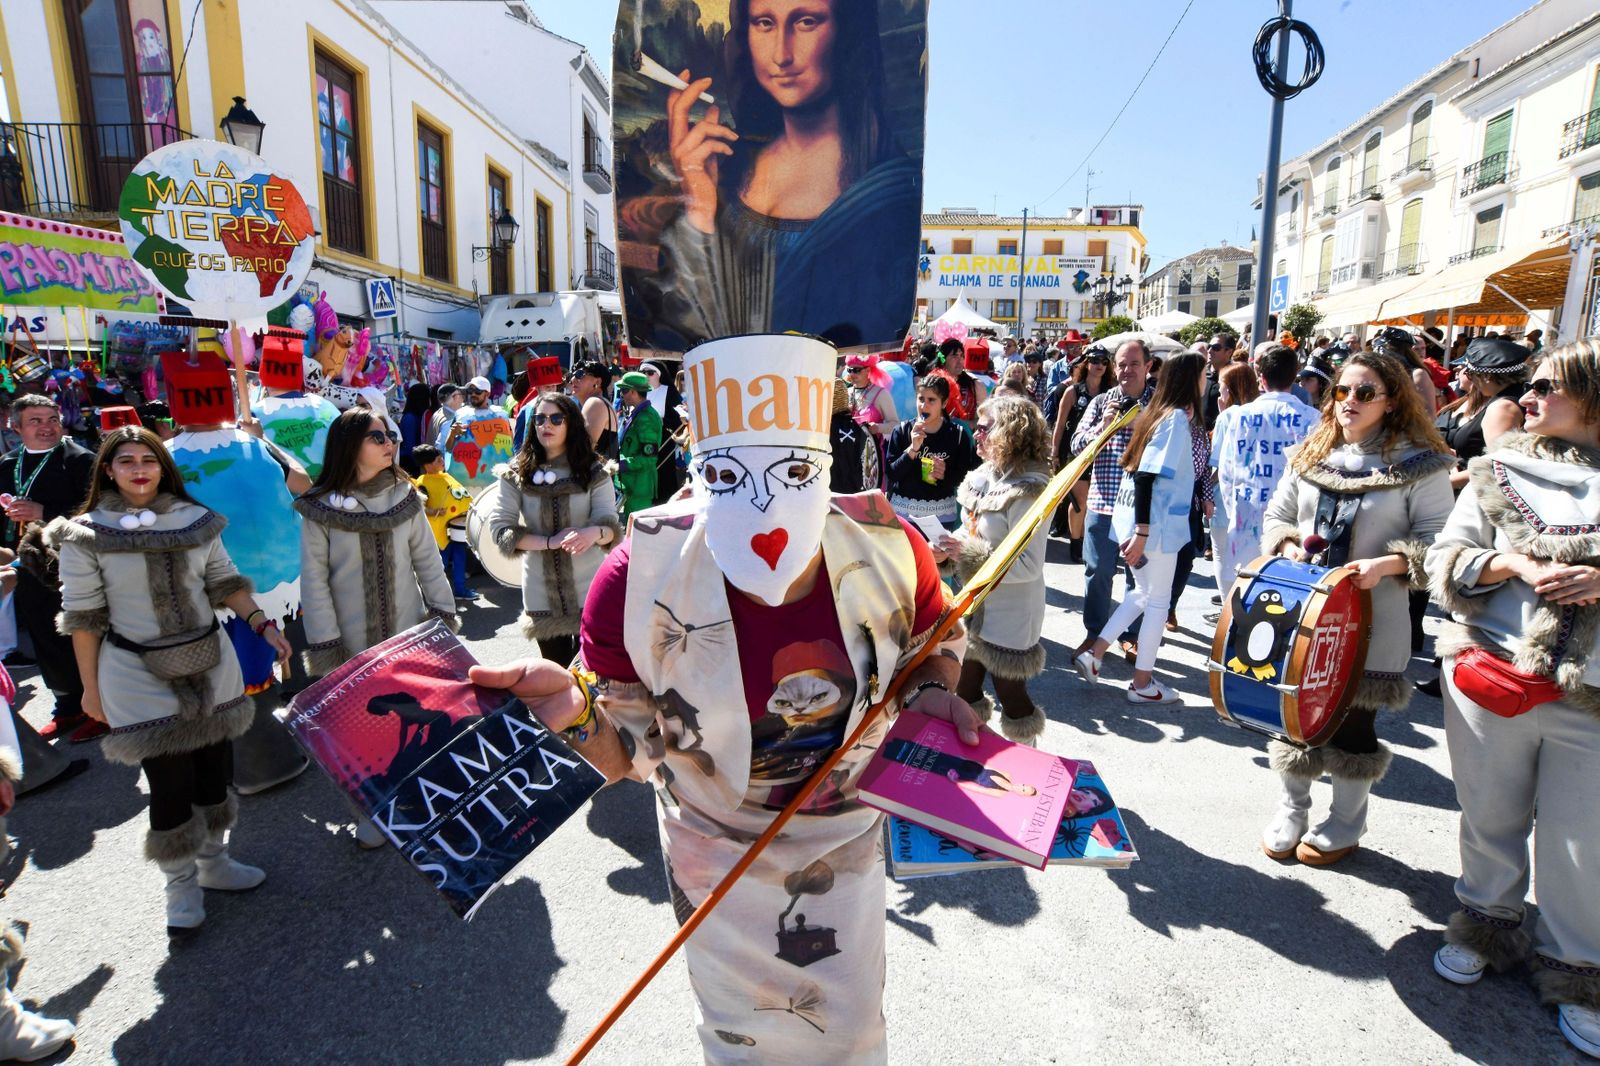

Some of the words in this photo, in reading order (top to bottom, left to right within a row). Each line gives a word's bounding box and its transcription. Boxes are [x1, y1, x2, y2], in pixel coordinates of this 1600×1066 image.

[193, 158, 235, 179] LA
[146, 176, 285, 212] MADRE
[131, 207, 301, 247] TIERRA
[938, 255, 1064, 275] CARNAVAL
[939, 274, 981, 288] ALHAMA
[989, 274, 1003, 287] DE
[1010, 274, 1060, 288] GRANADA
[0, 316, 47, 333] AS
[264, 359, 300, 378] TNT
[541, 364, 559, 376] TNT
[176, 386, 228, 408] TNT
[1241, 413, 1264, 427] NO
[1276, 413, 1302, 428] ME
[349, 638, 431, 689] ENCICLOPEDIA
[431, 630, 452, 645] DEL
[372, 713, 546, 849] KAMA
[410, 746, 581, 889] SUTRA
